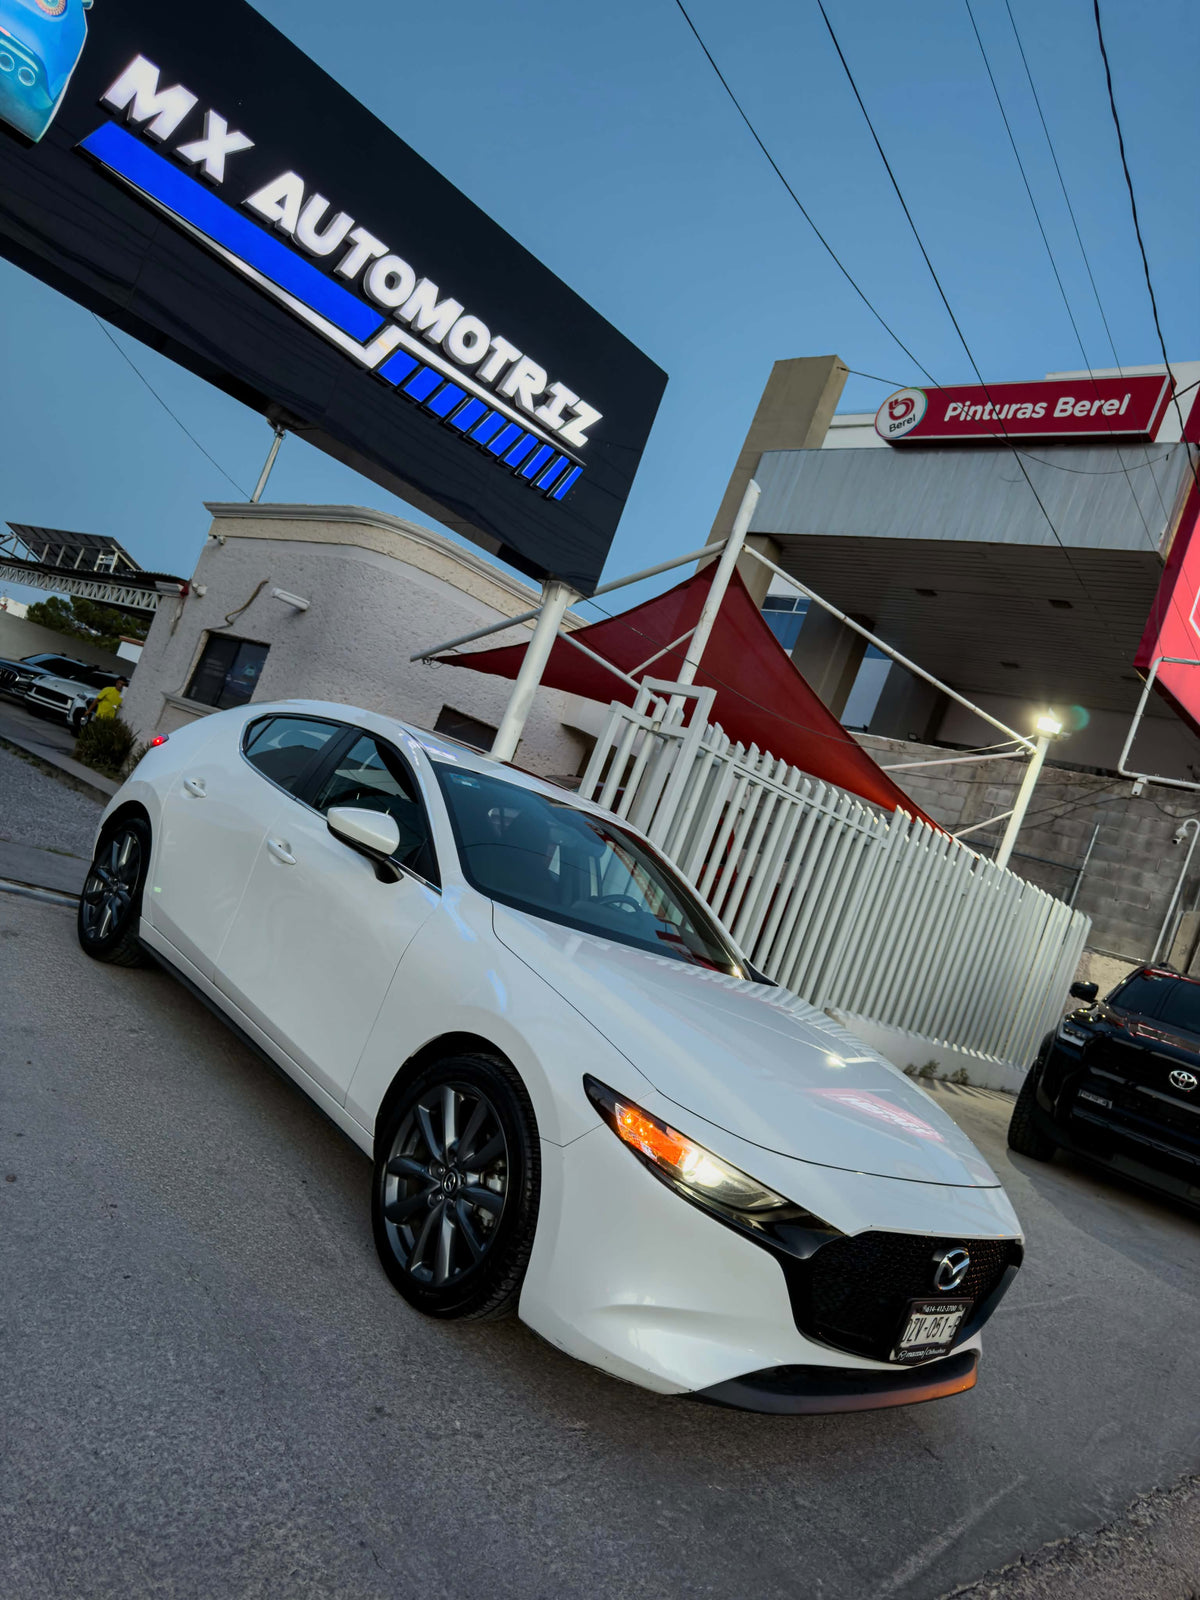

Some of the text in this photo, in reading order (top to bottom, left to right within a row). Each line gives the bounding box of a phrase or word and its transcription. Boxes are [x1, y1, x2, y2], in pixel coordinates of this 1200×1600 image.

[101, 54, 602, 447] MX AUTOMOTRIZ
[943, 393, 1131, 422] Pinturas Berel
[889, 414, 916, 432] Berel
